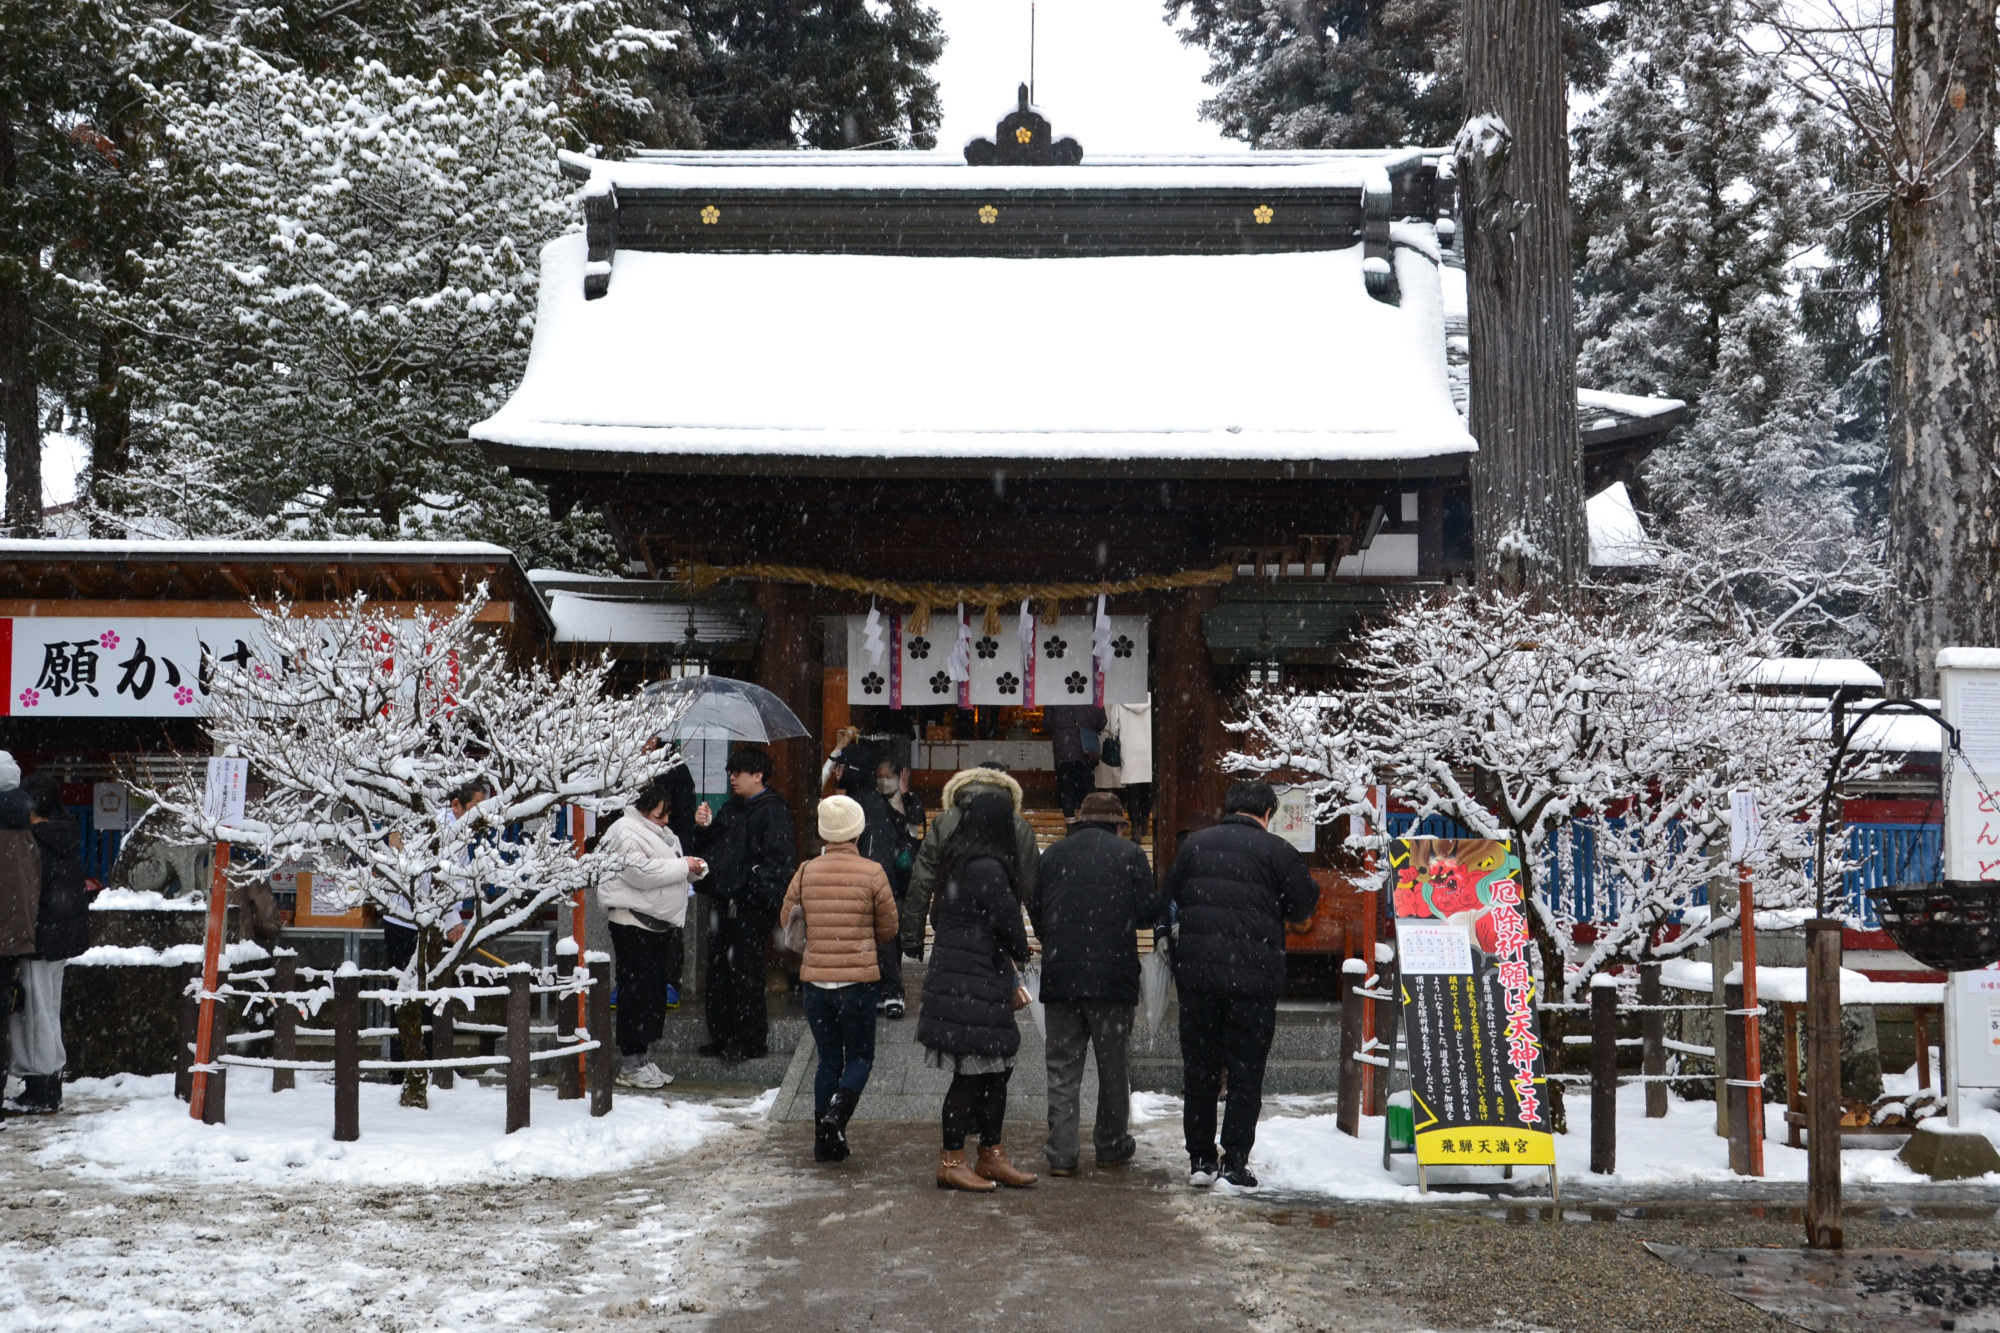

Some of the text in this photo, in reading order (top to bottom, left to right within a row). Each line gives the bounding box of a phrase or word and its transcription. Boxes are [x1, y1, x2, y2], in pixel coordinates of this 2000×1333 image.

[1490, 878, 1542, 1122] 厄除祈願は天神さま
[1441, 1138, 1529, 1154] 飛騨天満宮
